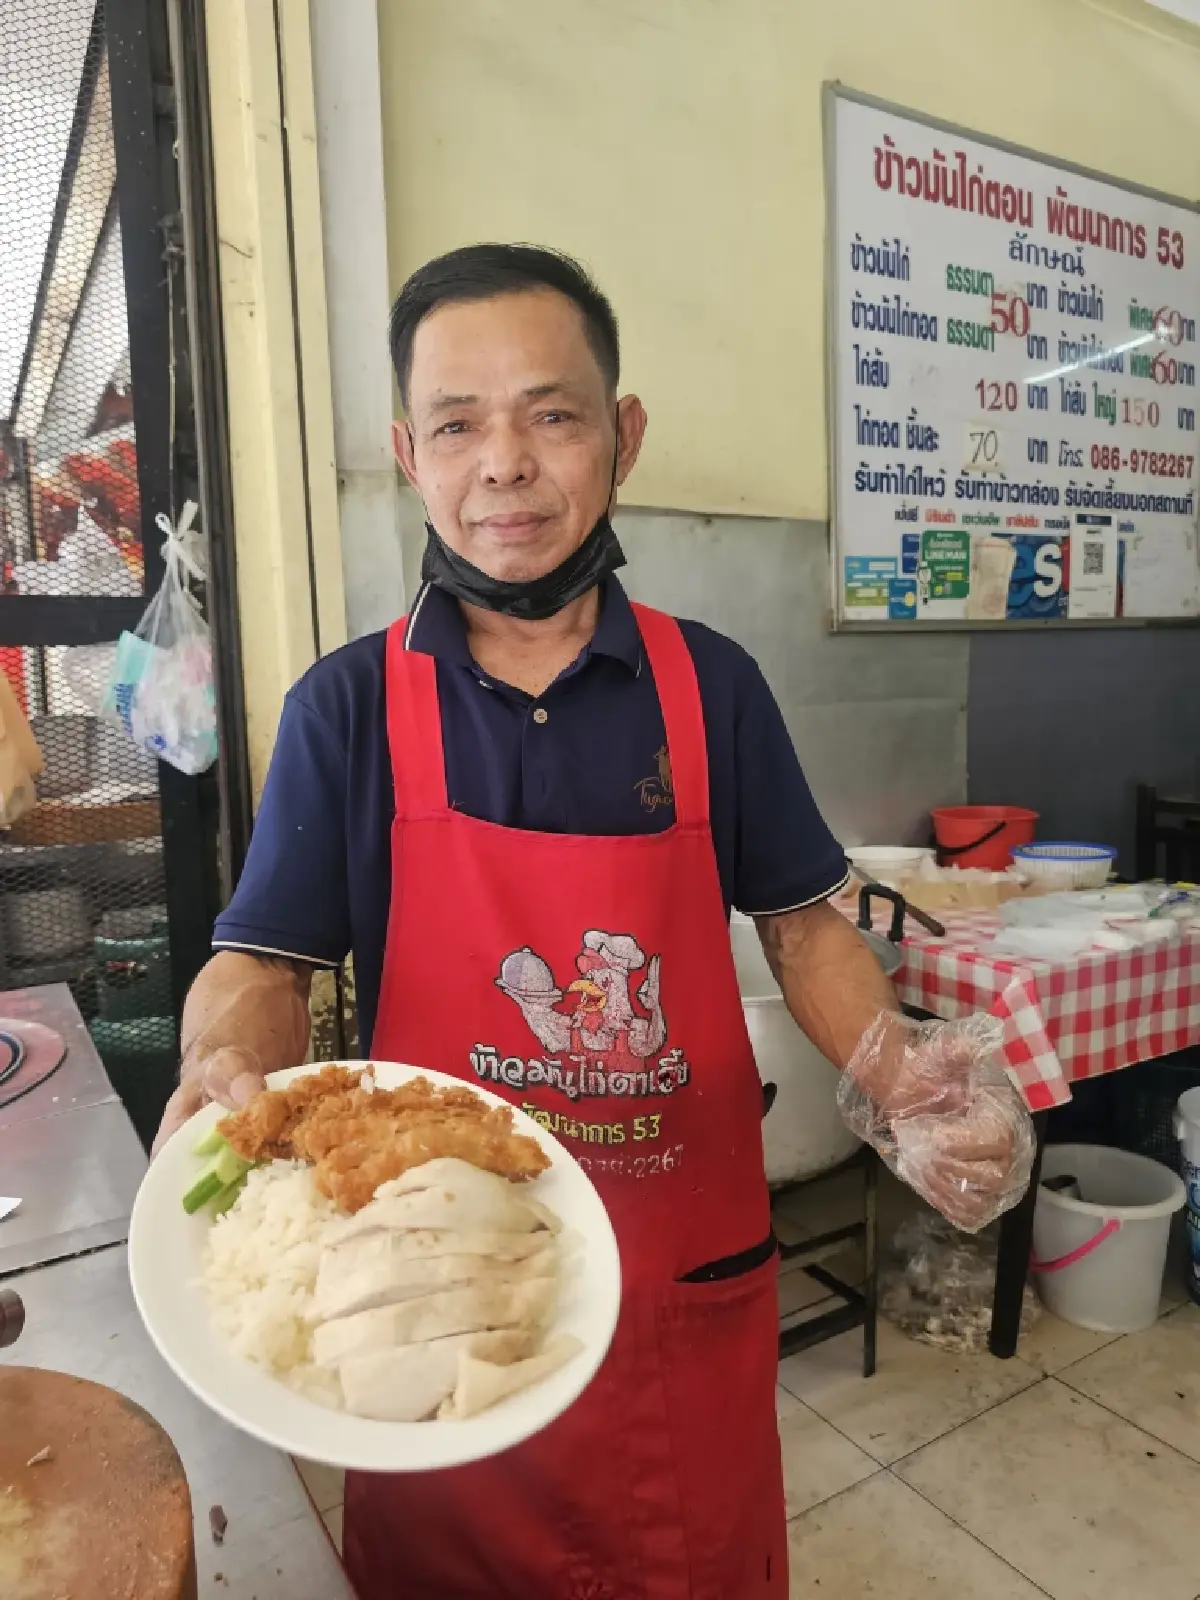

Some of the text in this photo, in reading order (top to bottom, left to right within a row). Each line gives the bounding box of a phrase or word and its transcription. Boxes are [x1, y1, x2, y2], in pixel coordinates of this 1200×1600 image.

[873, 133, 1184, 269] ข้าวมันไก่ตอน พัฒนาการ 53
[851, 232, 910, 281] ข้าวมันไก่
[990, 291, 1030, 337] 50
[1026, 282, 1048, 310] บาท
[1057, 280, 1104, 322] ข้าวมันไก่
[851, 291, 937, 342] ข้าวมันไก่ทอด
[945, 317, 995, 352] ธรรมดา
[1026, 333, 1048, 360] บาท
[1151, 350, 1178, 385] 60
[852, 343, 1196, 432] ไก่สับ 120 บาท ไก่สับ ใหญ่ 150 บาท
[852, 404, 900, 448] ไก่ทอด
[904, 406, 940, 452] ชิ้นละ
[1027, 436, 1049, 465] บาท
[1090, 443, 1195, 479] 086-9782267
[854, 461, 947, 498] รับทำไก่ไหว้
[955, 469, 1060, 507] รับทำข้าวกล่อง
[633, 1114, 662, 1140] 53
